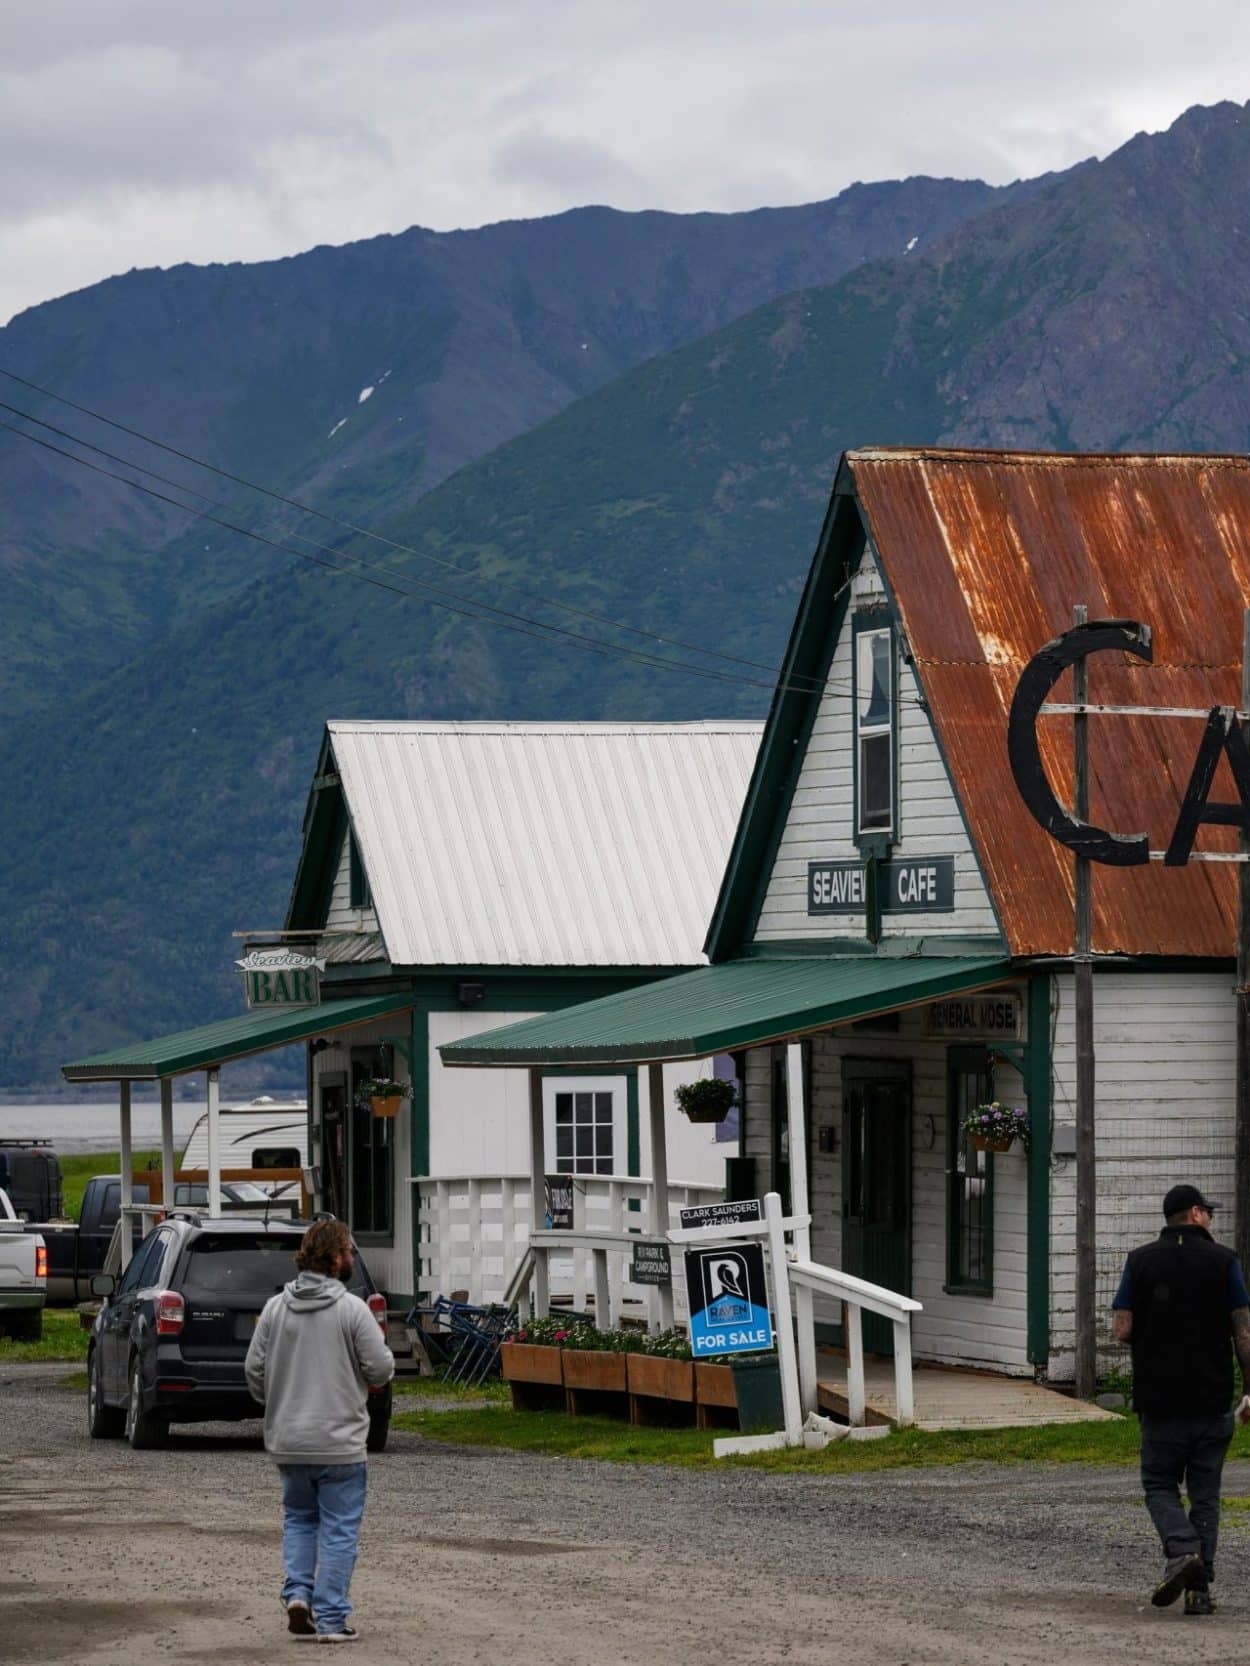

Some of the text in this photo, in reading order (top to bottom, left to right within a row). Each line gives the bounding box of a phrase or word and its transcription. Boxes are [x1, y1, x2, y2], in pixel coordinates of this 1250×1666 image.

[813, 867, 937, 904] SEAVIE CAFE
[246, 951, 317, 969] Seaview
[252, 970, 314, 1002] BAR
[682, 1202, 758, 1220] CLARK SAUNDERS
[635, 1260, 669, 1274] CAMPGROUND
[711, 1303, 747, 1317] RAVEN
[697, 1329, 767, 1349] FOR SALE
